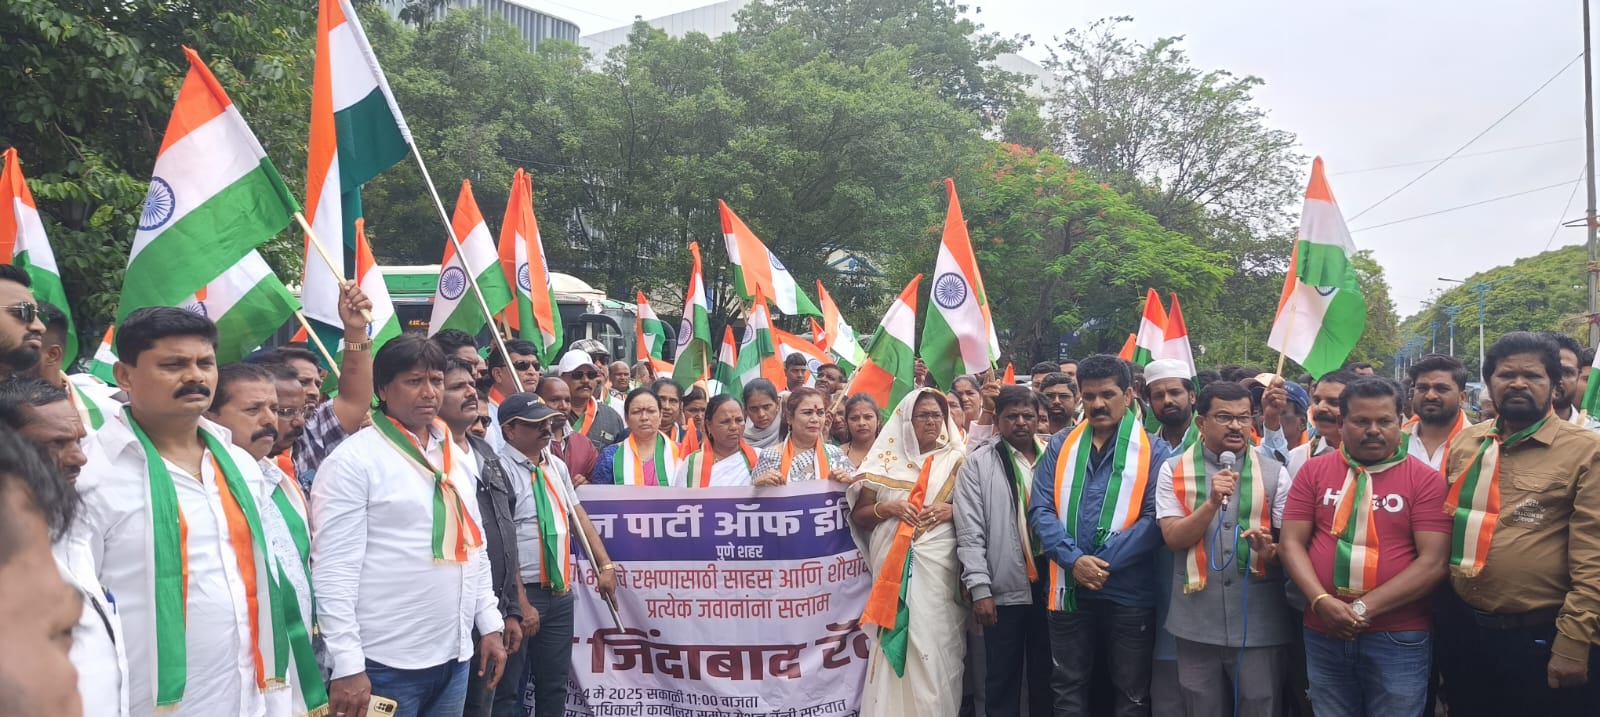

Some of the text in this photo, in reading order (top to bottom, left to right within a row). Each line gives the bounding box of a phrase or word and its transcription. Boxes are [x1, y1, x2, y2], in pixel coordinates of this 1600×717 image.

[1323, 488, 1404, 513] HO
[623, 504, 704, 538] पार्टी
[714, 503, 804, 537] ऑफ
[715, 542, 763, 561] पुणे शहर
[631, 563, 719, 590] रक्षणासाठी
[721, 569, 774, 589] साहस
[778, 560, 824, 589] आणि
[645, 592, 832, 620] प्रत्येक जवानांना सलाम
[587, 628, 808, 681] जिंदाबाद
[593, 685, 605, 700] मे
[609, 688, 643, 700] 2025
[646, 688, 684, 704] सकाळी
[687, 694, 718, 706] 11:00
[720, 695, 759, 708] वाजता
